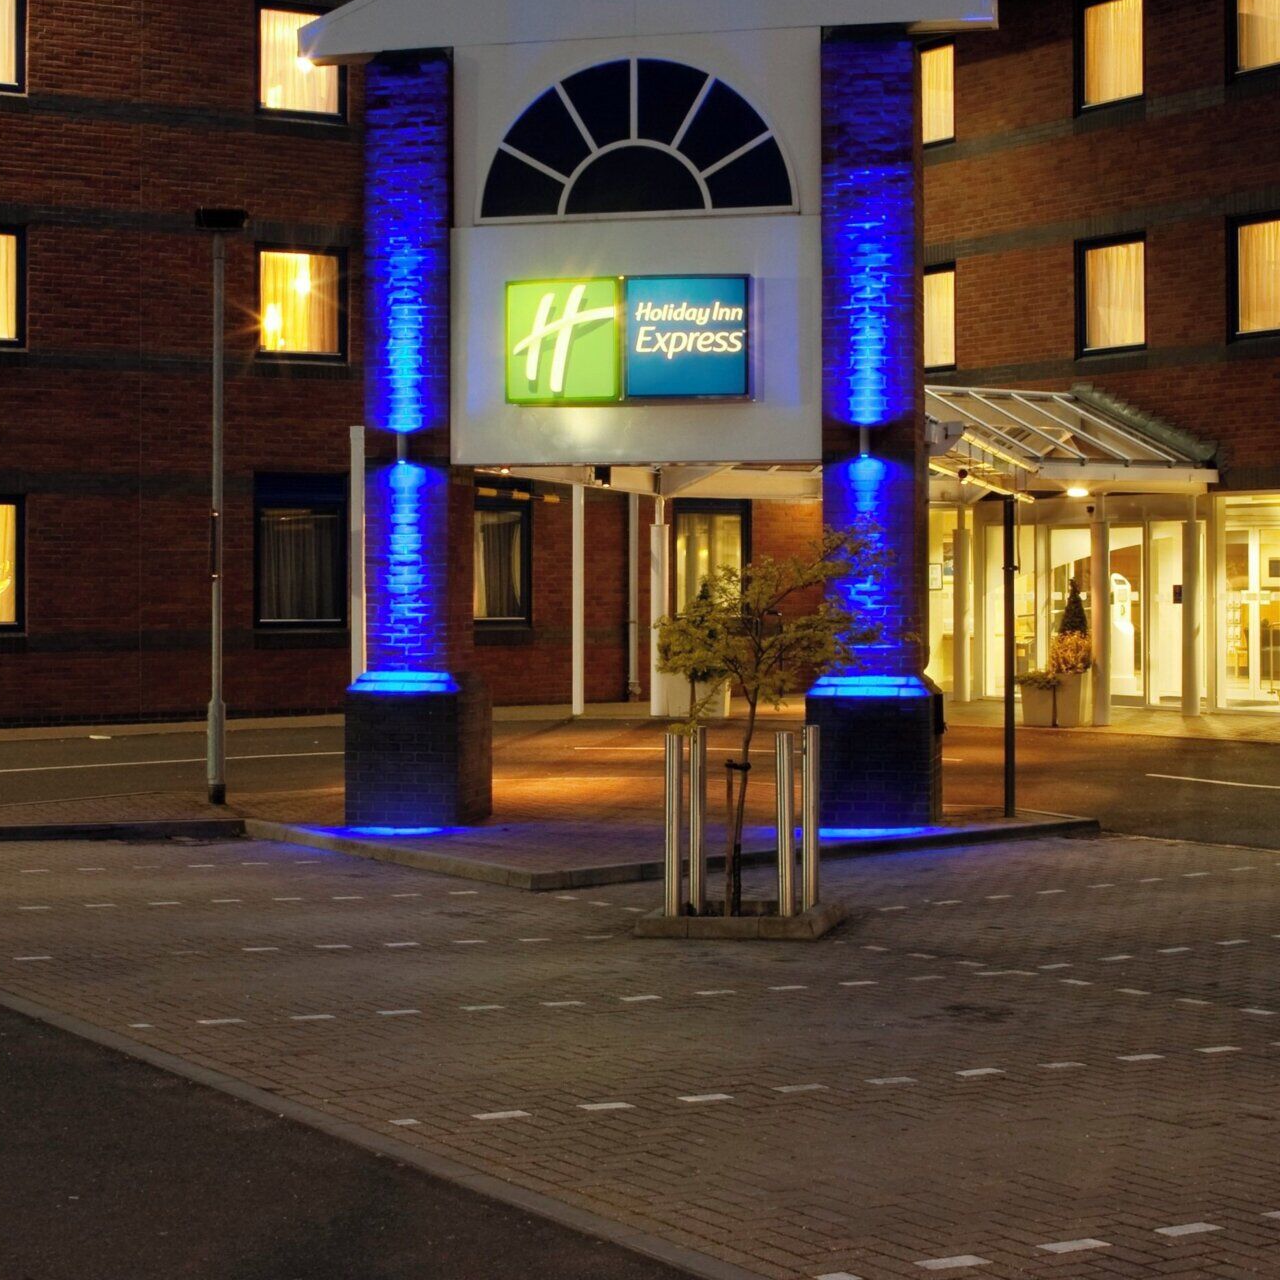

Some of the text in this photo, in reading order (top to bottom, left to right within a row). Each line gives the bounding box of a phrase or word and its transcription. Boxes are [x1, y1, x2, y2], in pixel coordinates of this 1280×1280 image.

[635, 301, 743, 325] Holiday Inn
[635, 326, 743, 360] Express
